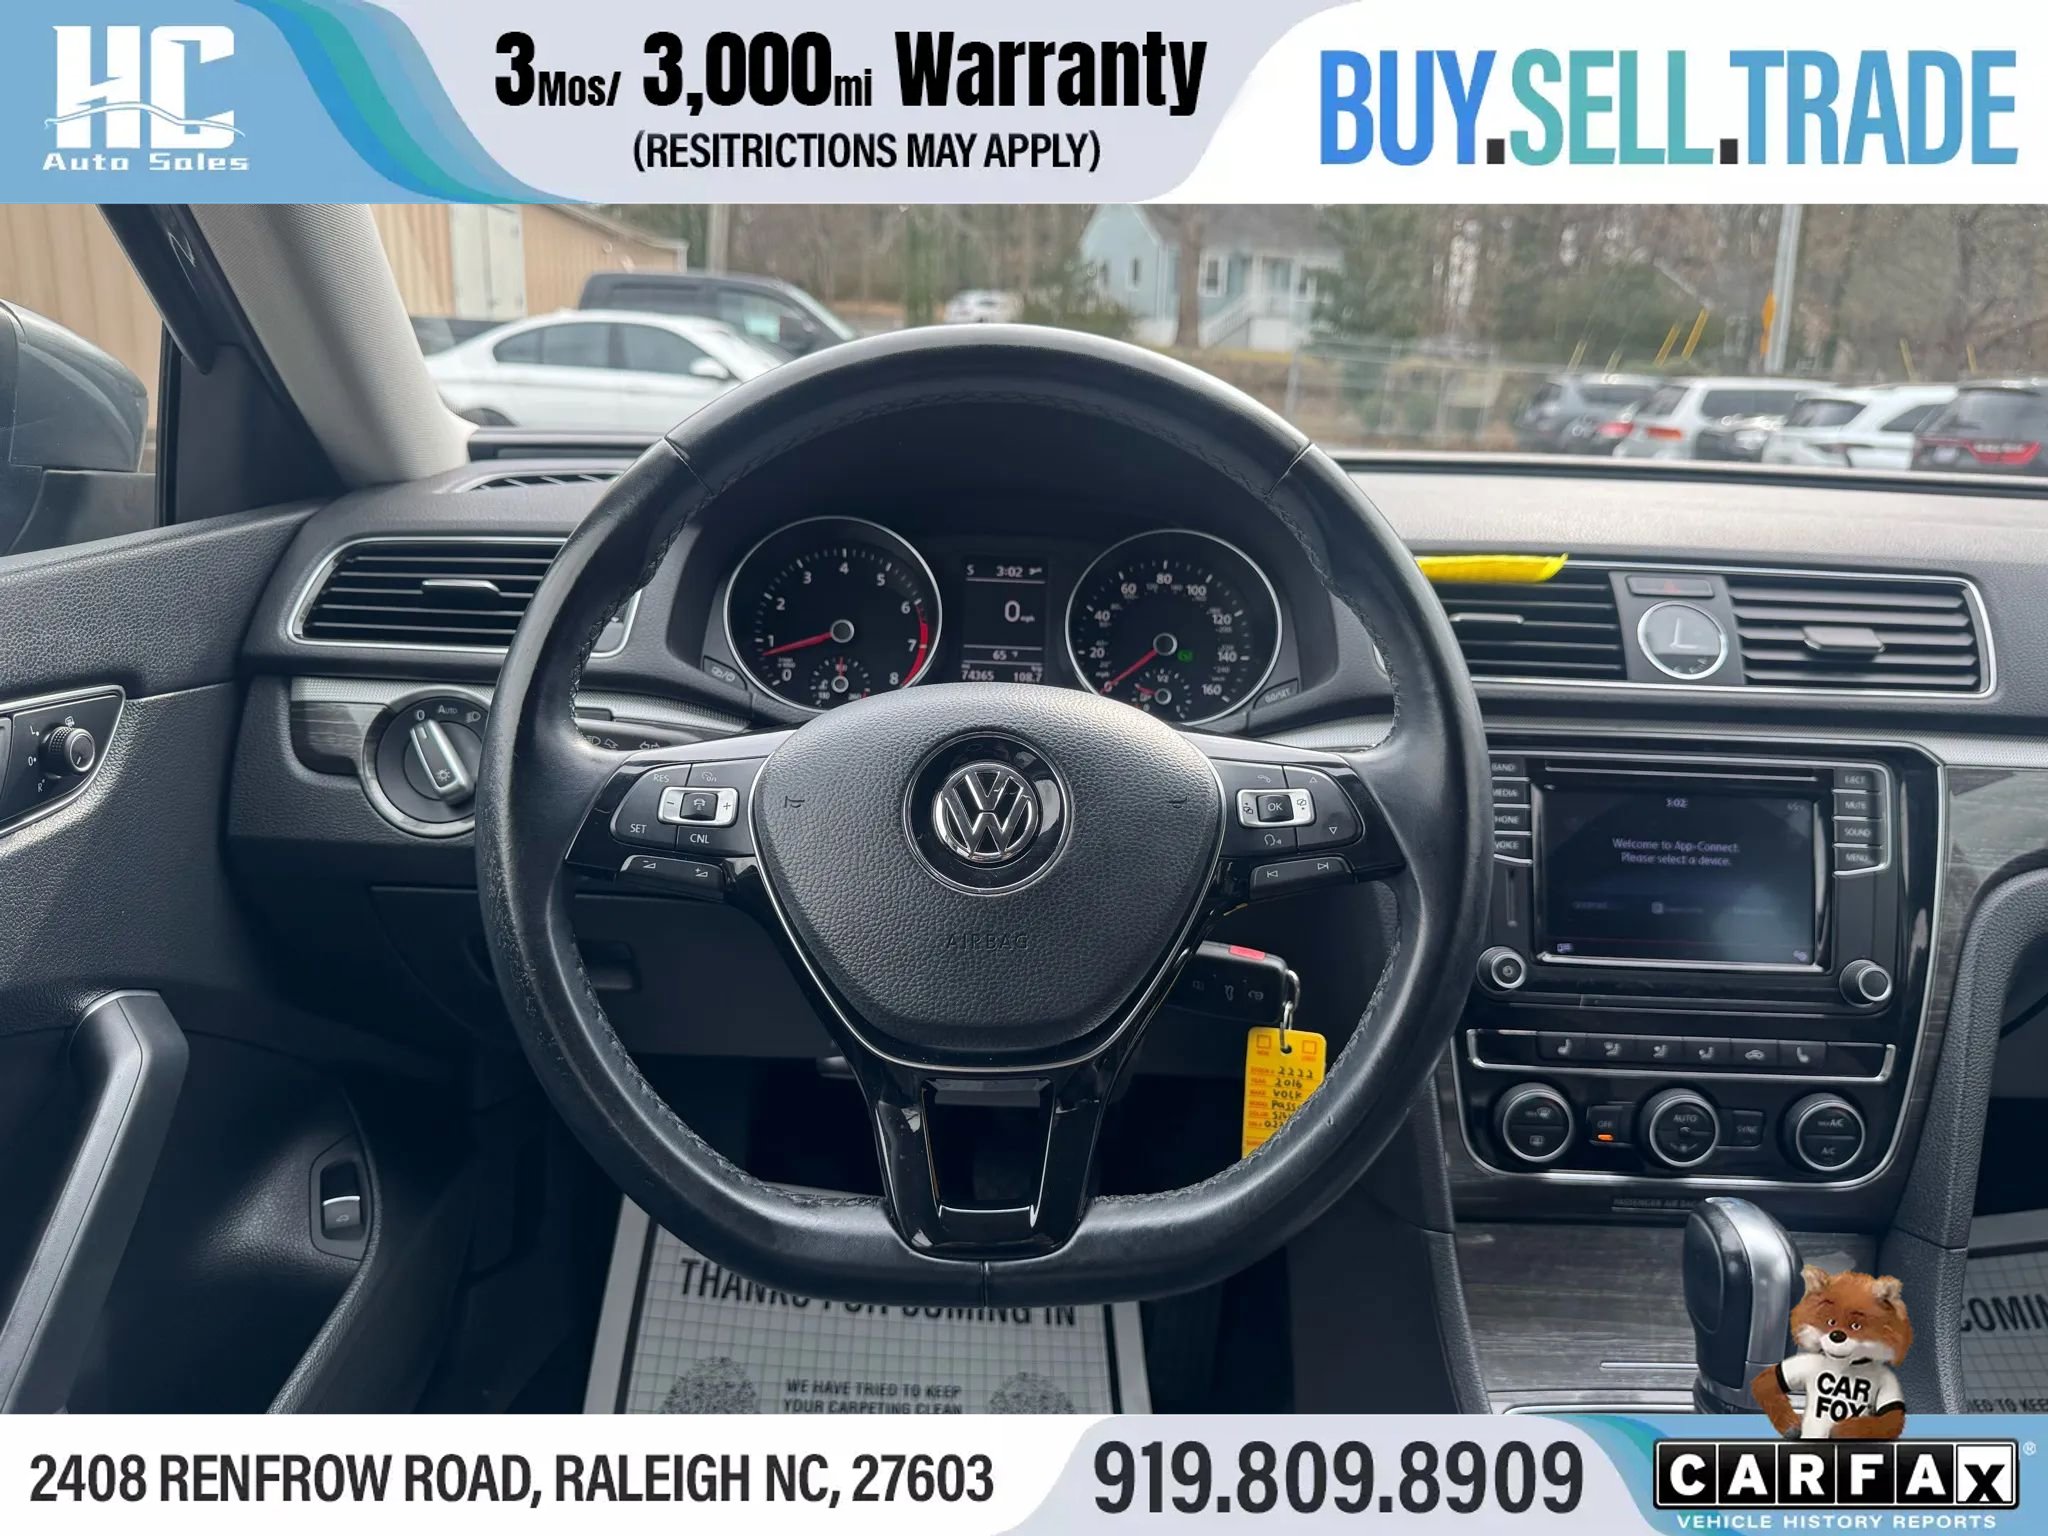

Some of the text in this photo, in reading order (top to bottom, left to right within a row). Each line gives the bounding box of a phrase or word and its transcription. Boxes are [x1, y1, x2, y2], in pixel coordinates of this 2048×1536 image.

[839, 562, 849, 574] 4
[966, 564, 975, 576] S
[996, 566, 1023, 578] 3:02
[803, 571, 812, 584] 3
[876, 574, 885, 586] 5
[1156, 573, 1173, 585] 80
[1121, 583, 1136, 594] 60
[1187, 584, 1207, 596] 100
[776, 598, 785, 610] 2
[901, 602, 910, 614] 6
[1004, 600, 1020, 622] 0
[1094, 610, 1110, 621] 40
[1212, 614, 1232, 625] 120
[768, 635, 775, 647] 1
[908, 639, 916, 651] 7
[992, 650, 1007, 661] 65
[1089, 647, 1105, 659] 20
[1218, 651, 1237, 663] 140
[782, 668, 792, 682] 0
[889, 672, 899, 685] 8
[961, 670, 994, 681] 74365
[1013, 671, 1042, 683] 108.7
[1202, 684, 1222, 696] 160
[653, 773, 670, 783] RES
[1844, 775, 1866, 785] EJECT
[1267, 802, 1283, 812] OK
[1845, 801, 1867, 810] MUTE
[630, 824, 647, 834] SET
[1844, 827, 1872, 838] SOUND
[690, 833, 710, 845] CNL
[1612, 838, 1659, 850] Welcome
[1661, 840, 1673, 850] to
[1621, 852, 1655, 863] Please
[1658, 854, 1686, 864] select
[1845, 853, 1868, 862] MENU
[946, 933, 1029, 950] AIRBAG
[1597, 1120, 1613, 1129] OFF
[1673, 1114, 1698, 1123] AUTO
[1829, 1118, 1844, 1129] A/C
[1736, 1125, 1759, 1135] SYNC
[1820, 1146, 1836, 1156] A/C
[787, 1378, 962, 1399] WE HAVE TRIED TO KEEP
[784, 1398, 962, 1414] YOUR CARPETING CLEAN
